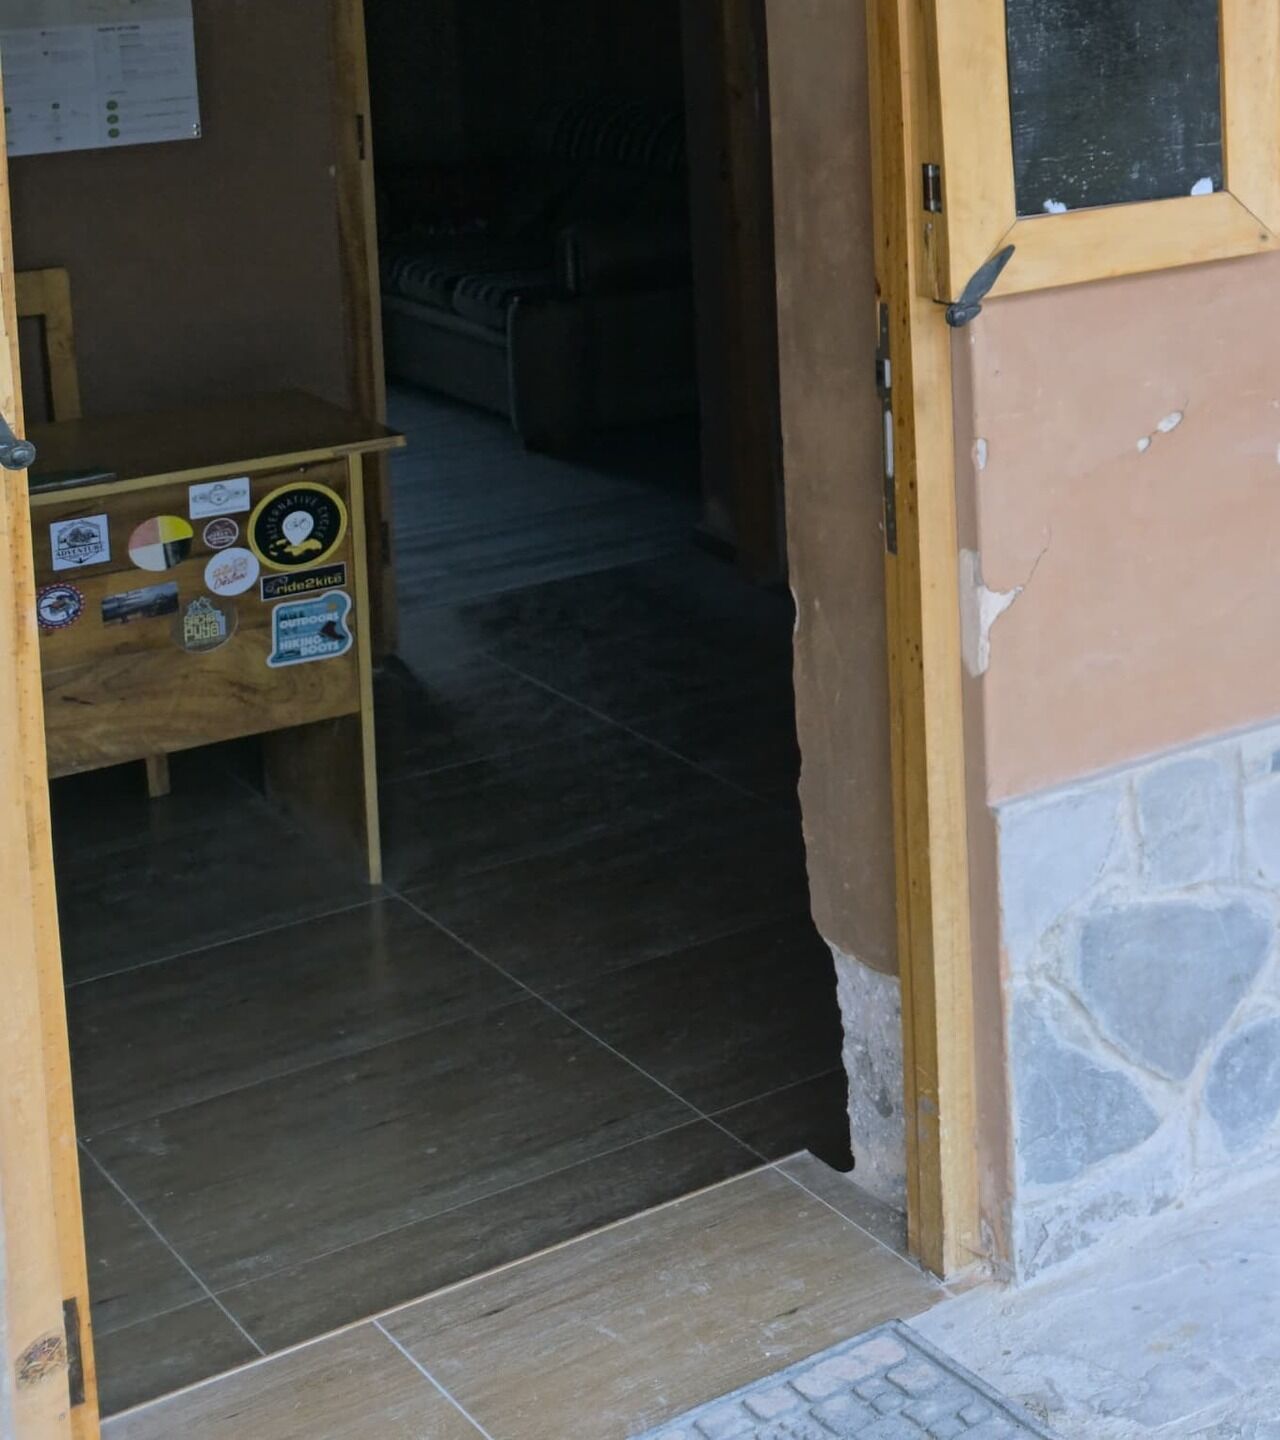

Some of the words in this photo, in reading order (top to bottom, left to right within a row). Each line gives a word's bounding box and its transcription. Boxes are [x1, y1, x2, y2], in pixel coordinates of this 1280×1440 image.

[55, 543, 104, 557] ADVENTURE
[276, 575, 342, 594] ride2kite
[279, 612, 339, 629] OUTDOORS
[279, 635, 321, 649] HIKING
[300, 642, 339, 655] BOOTS
